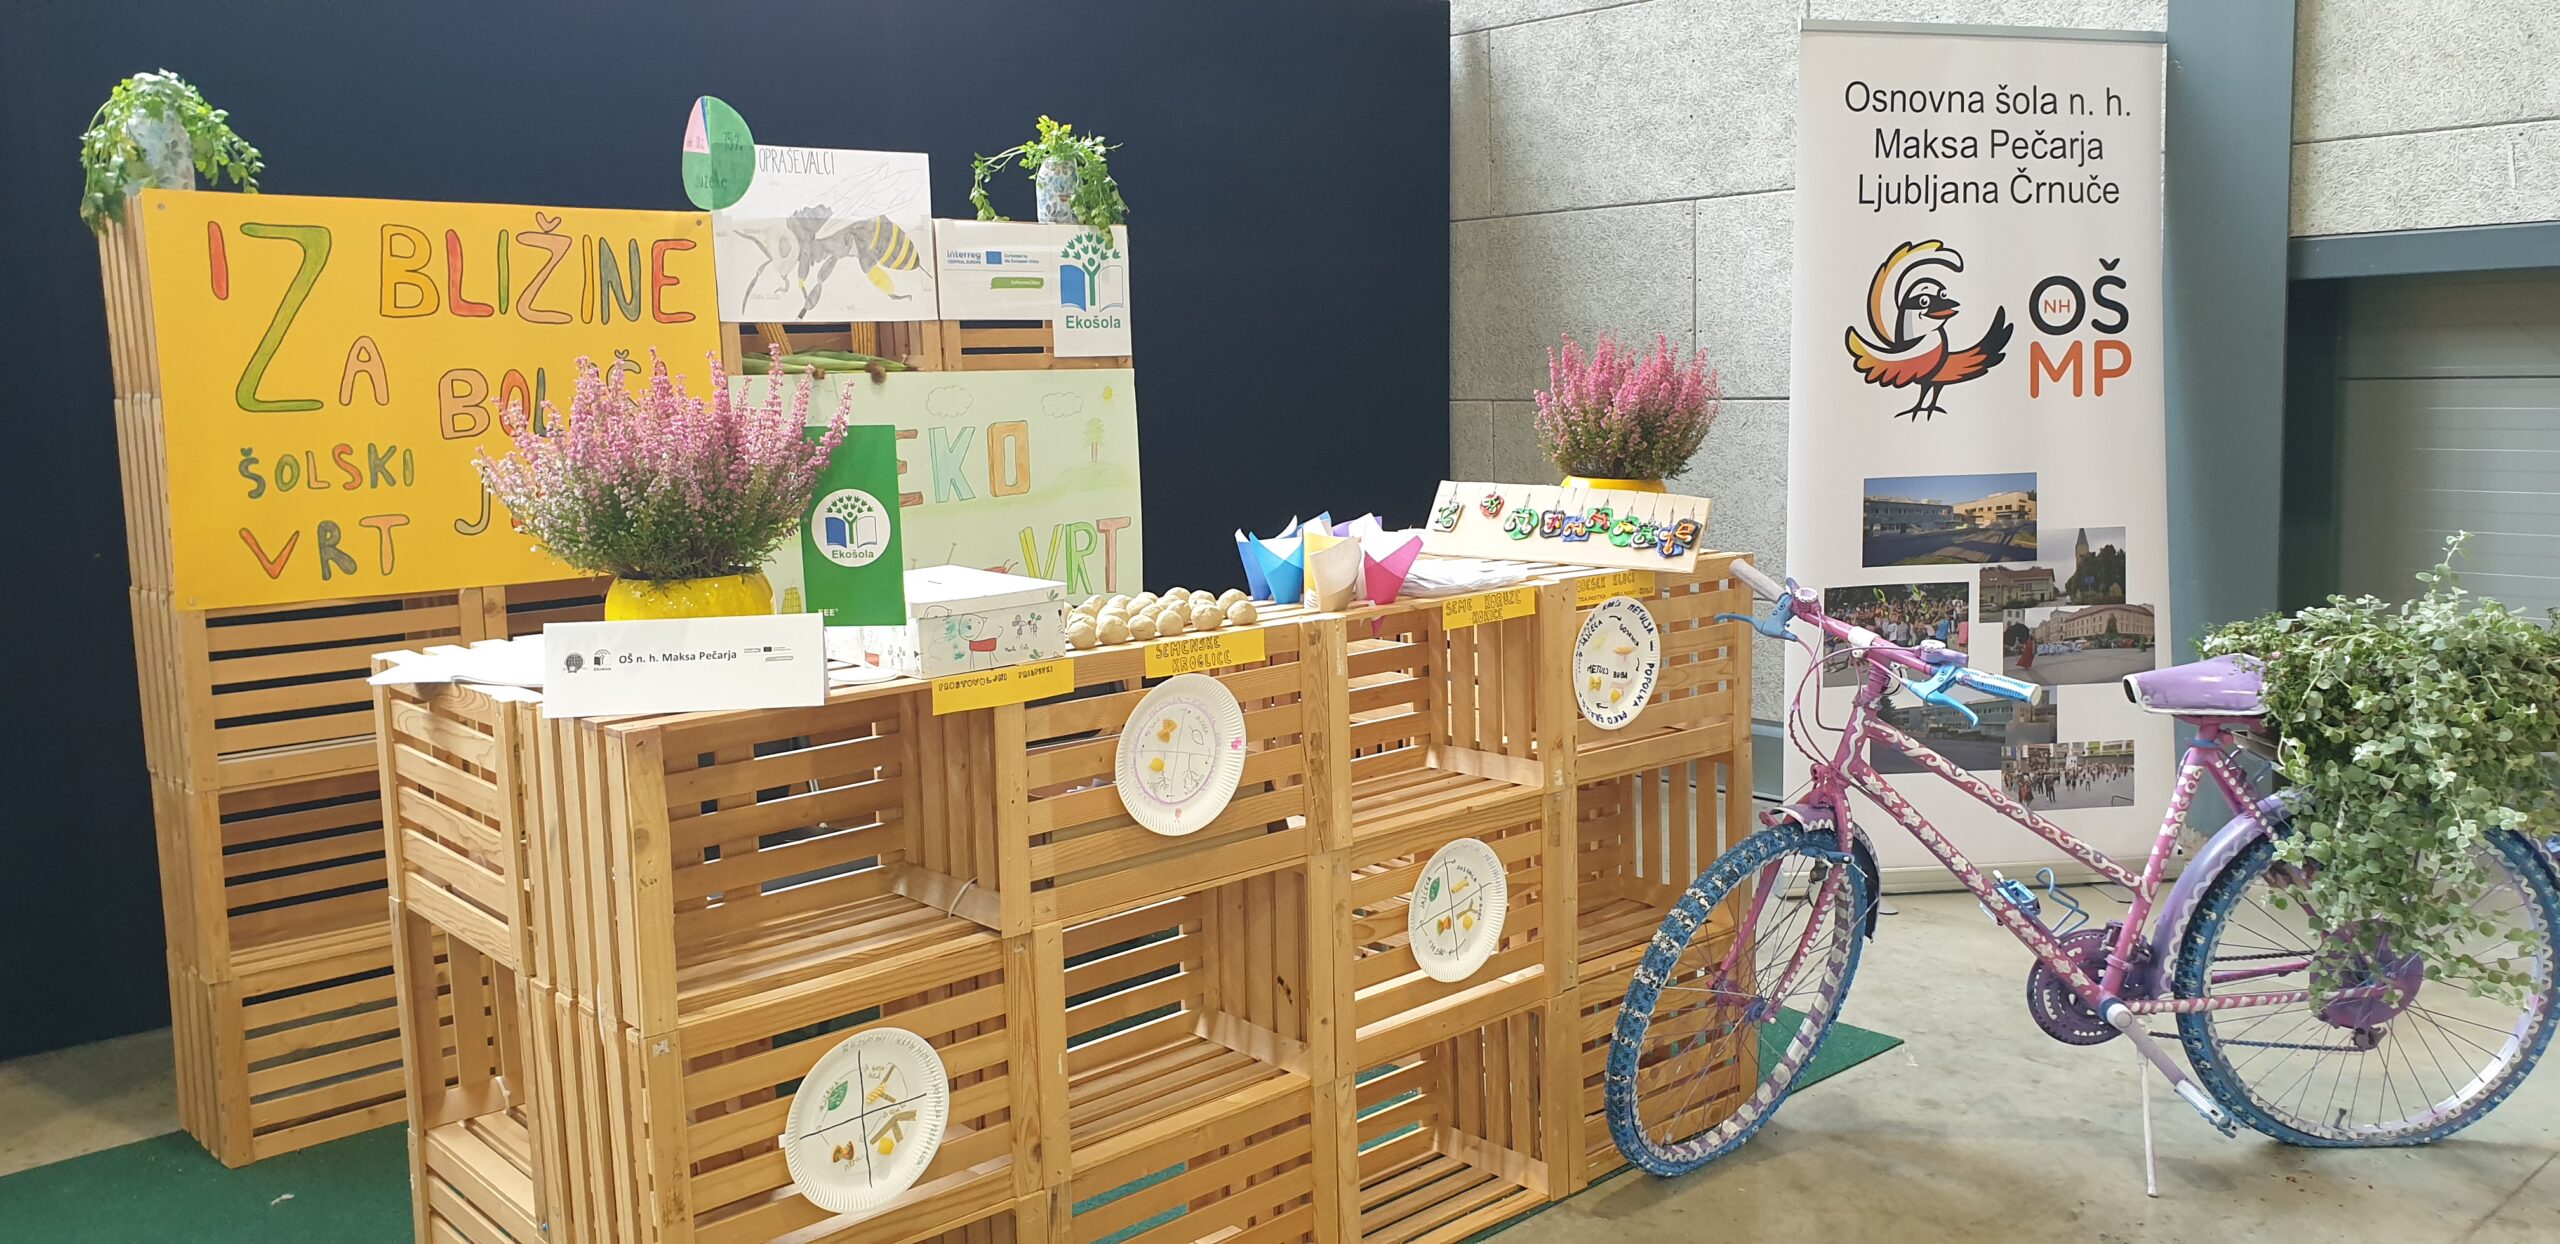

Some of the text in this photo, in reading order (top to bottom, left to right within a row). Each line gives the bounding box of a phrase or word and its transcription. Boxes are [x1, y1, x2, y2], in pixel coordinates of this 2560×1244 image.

[1845, 80, 2131, 117] Osnovna šola n. h.
[758, 147, 835, 176] OPRAŠEVALCI
[1874, 127, 2104, 168] Maksa Pečarja
[1858, 166, 2121, 213] Ljubljana Črnuče
[379, 211, 697, 325] BLIŽINE
[2028, 257, 2130, 336] OŠ
[2043, 299, 2072, 314] NH
[1065, 314, 1122, 329] Ekošola
[2029, 339, 2132, 399] MP
[238, 442, 416, 499] ŠOLSKI
[895, 419, 1032, 508] EKO
[238, 513, 411, 581] VRT
[831, 549, 874, 559] Ekošola
[1018, 516, 1132, 595] VRT
[1445, 589, 1522, 617] SEME KORUZE
[618, 650, 634, 664] OŠ
[636, 654, 647, 664] n.
[649, 652, 659, 663] h.
[662, 650, 696, 663] Maksa
[699, 649, 738, 662] Pečarja
[1155, 635, 1221, 659] SEMENSKE
[1172, 650, 1232, 674] KROGLICE
[1632, 662, 1655, 707] POPOLNA
